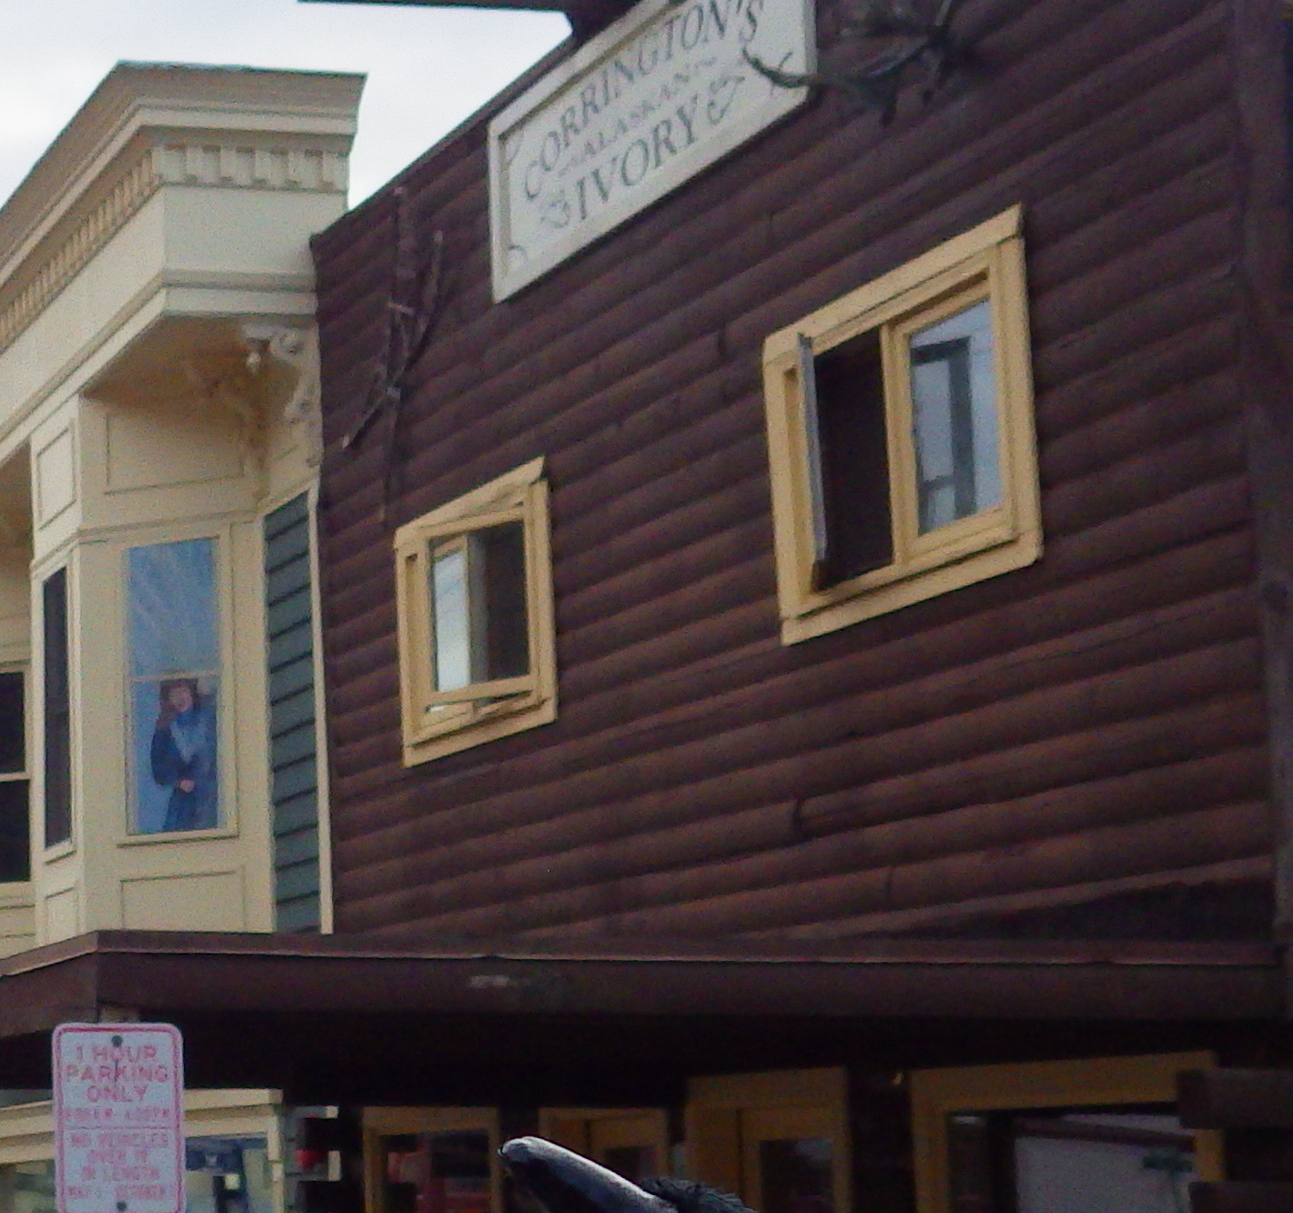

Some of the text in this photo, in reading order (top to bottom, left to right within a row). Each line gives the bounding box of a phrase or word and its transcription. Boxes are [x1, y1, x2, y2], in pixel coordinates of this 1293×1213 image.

[576, 95, 699, 220] IVORY
[92, 1045, 157, 1062] HOUR
[65, 1064, 169, 1083] PARKING
[86, 1085, 148, 1102] ONLY
